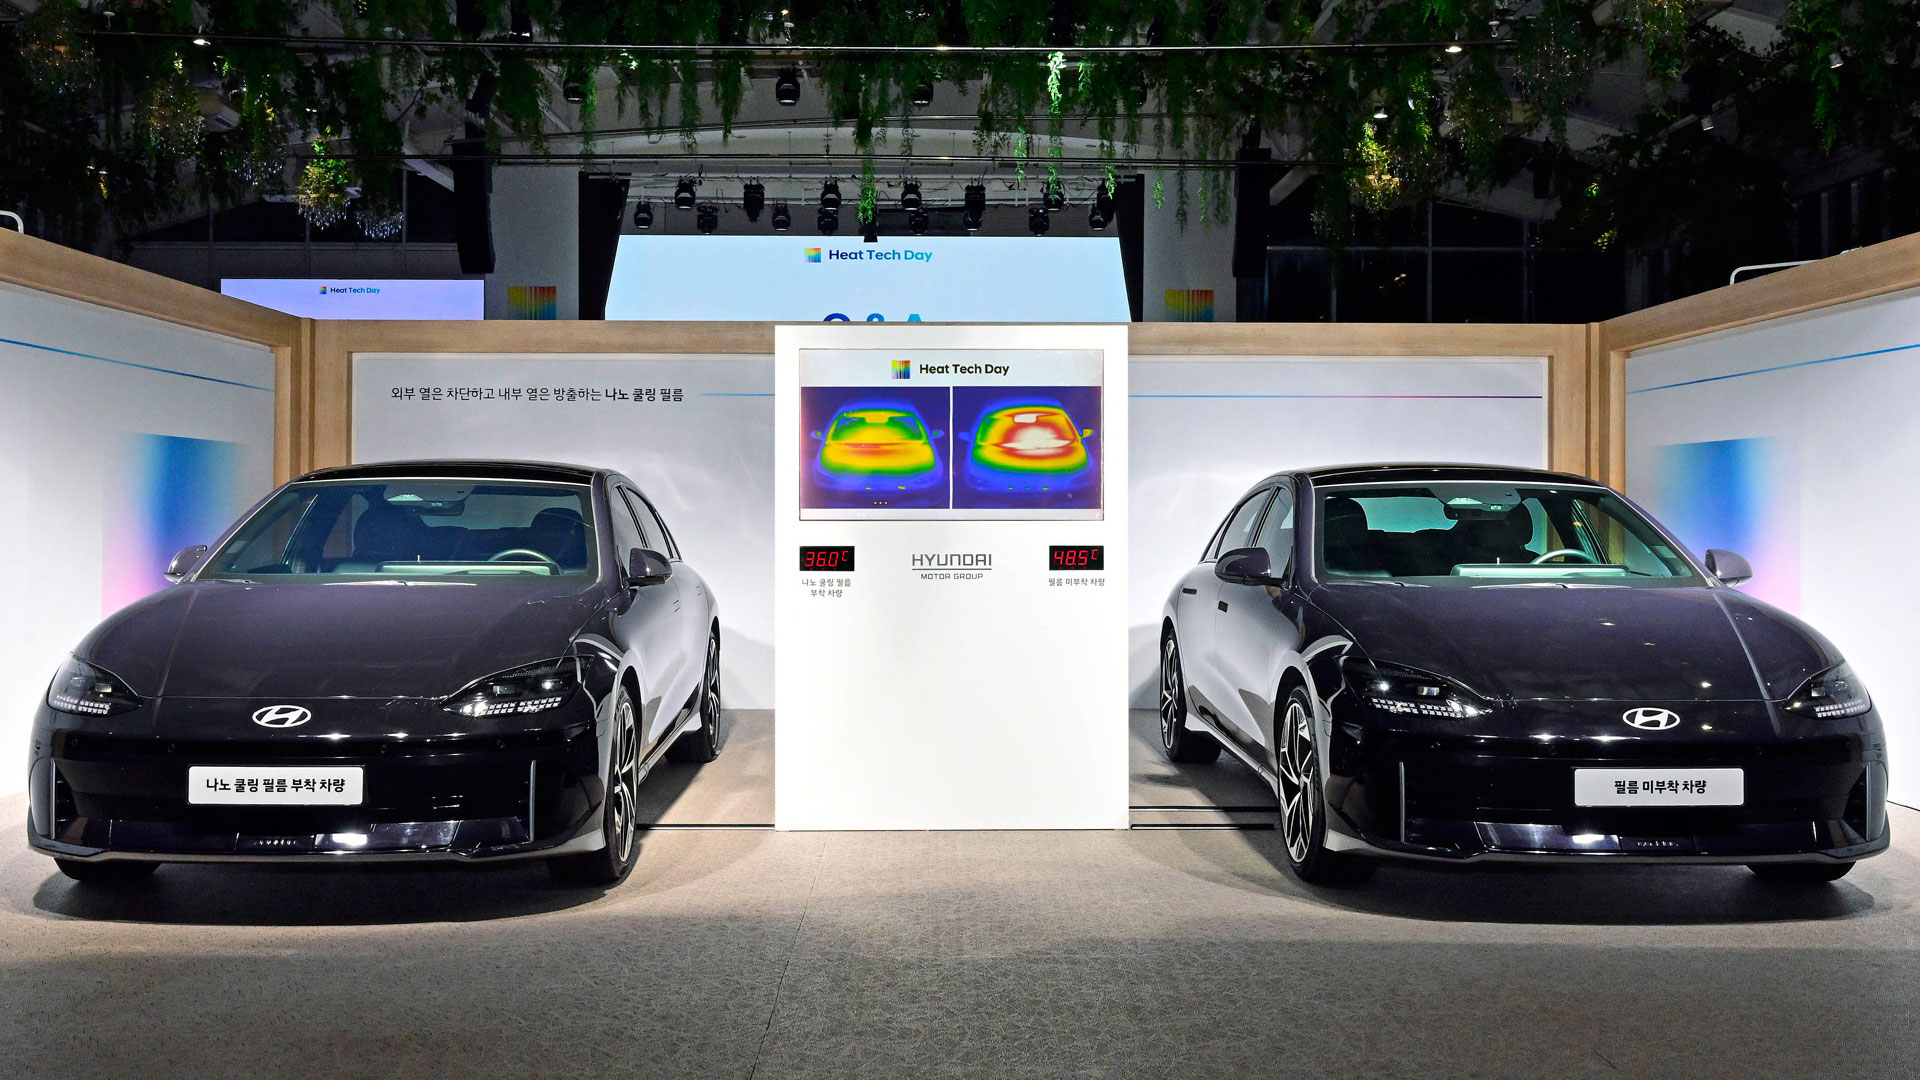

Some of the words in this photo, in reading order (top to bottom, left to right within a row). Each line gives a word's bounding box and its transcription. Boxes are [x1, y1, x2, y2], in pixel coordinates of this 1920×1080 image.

[828, 249, 864, 260] Heat
[866, 249, 901, 260] Tech
[904, 250, 933, 262] Day
[366, 287, 380, 295] Day
[919, 364, 949, 374] Heat
[952, 364, 982, 374] Tech
[984, 364, 1010, 376] Day
[391, 387, 415, 401] 외부
[419, 387, 443, 401] 열은
[446, 387, 495, 401] 차단하고
[498, 387, 523, 401] 내부
[526, 387, 550, 401] 열은
[553, 387, 602, 401] 방출하는
[605, 387, 630, 401] 나노
[632, 387, 656, 402] 쿨링
[659, 387, 684, 402] 필름
[911, 553, 992, 566] HYUNDAI
[801, 578, 817, 587] 나노
[819, 578, 834, 587] 쿨링
[836, 578, 851, 587] 필름
[1048, 577, 1063, 587] 필름
[1065, 577, 1088, 587] 미부착
[1090, 577, 1105, 587] 차량
[810, 588, 826, 597] 부착
[827, 588, 843, 598] 차량
[206, 778, 231, 792] 나노
[234, 778, 259, 793] 쿨링
[262, 778, 288, 793] 필름
[291, 778, 317, 793] 부착
[319, 778, 346, 793] 차량
[1614, 780, 1639, 795] 필름
[1642, 780, 1680, 794] 미부착
[1682, 780, 1707, 794] 차량
